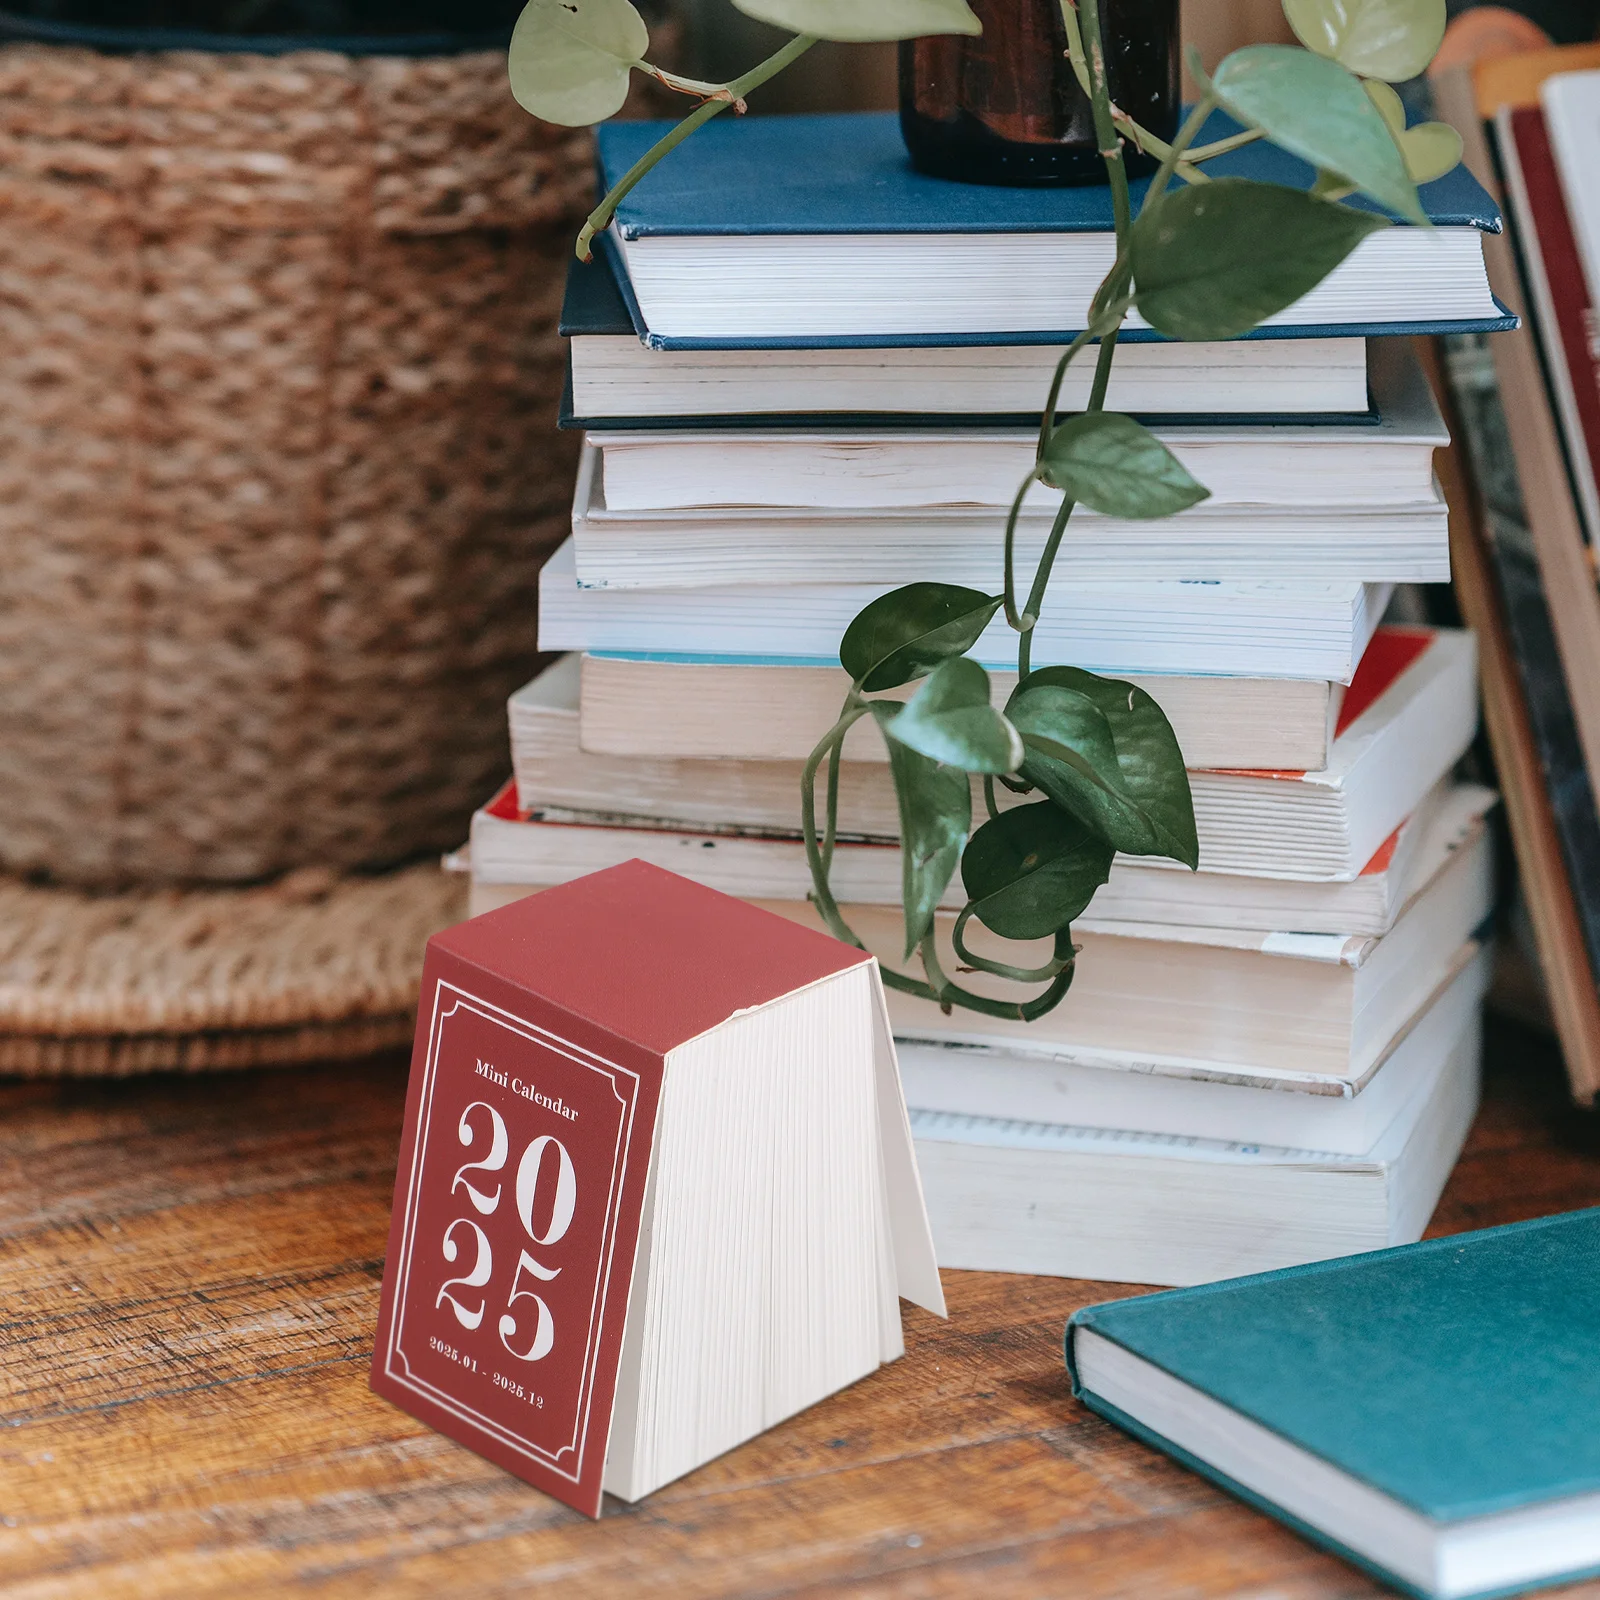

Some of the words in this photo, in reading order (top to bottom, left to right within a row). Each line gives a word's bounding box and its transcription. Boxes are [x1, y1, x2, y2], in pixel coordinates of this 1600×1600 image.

[474, 1058, 509, 1089] Mini
[510, 1077, 579, 1122] Calendar
[450, 1101, 577, 1246] 20
[435, 1217, 563, 1362] 25
[429, 1335, 478, 1373] 2025.01
[492, 1371, 544, 1410] 2025.12
